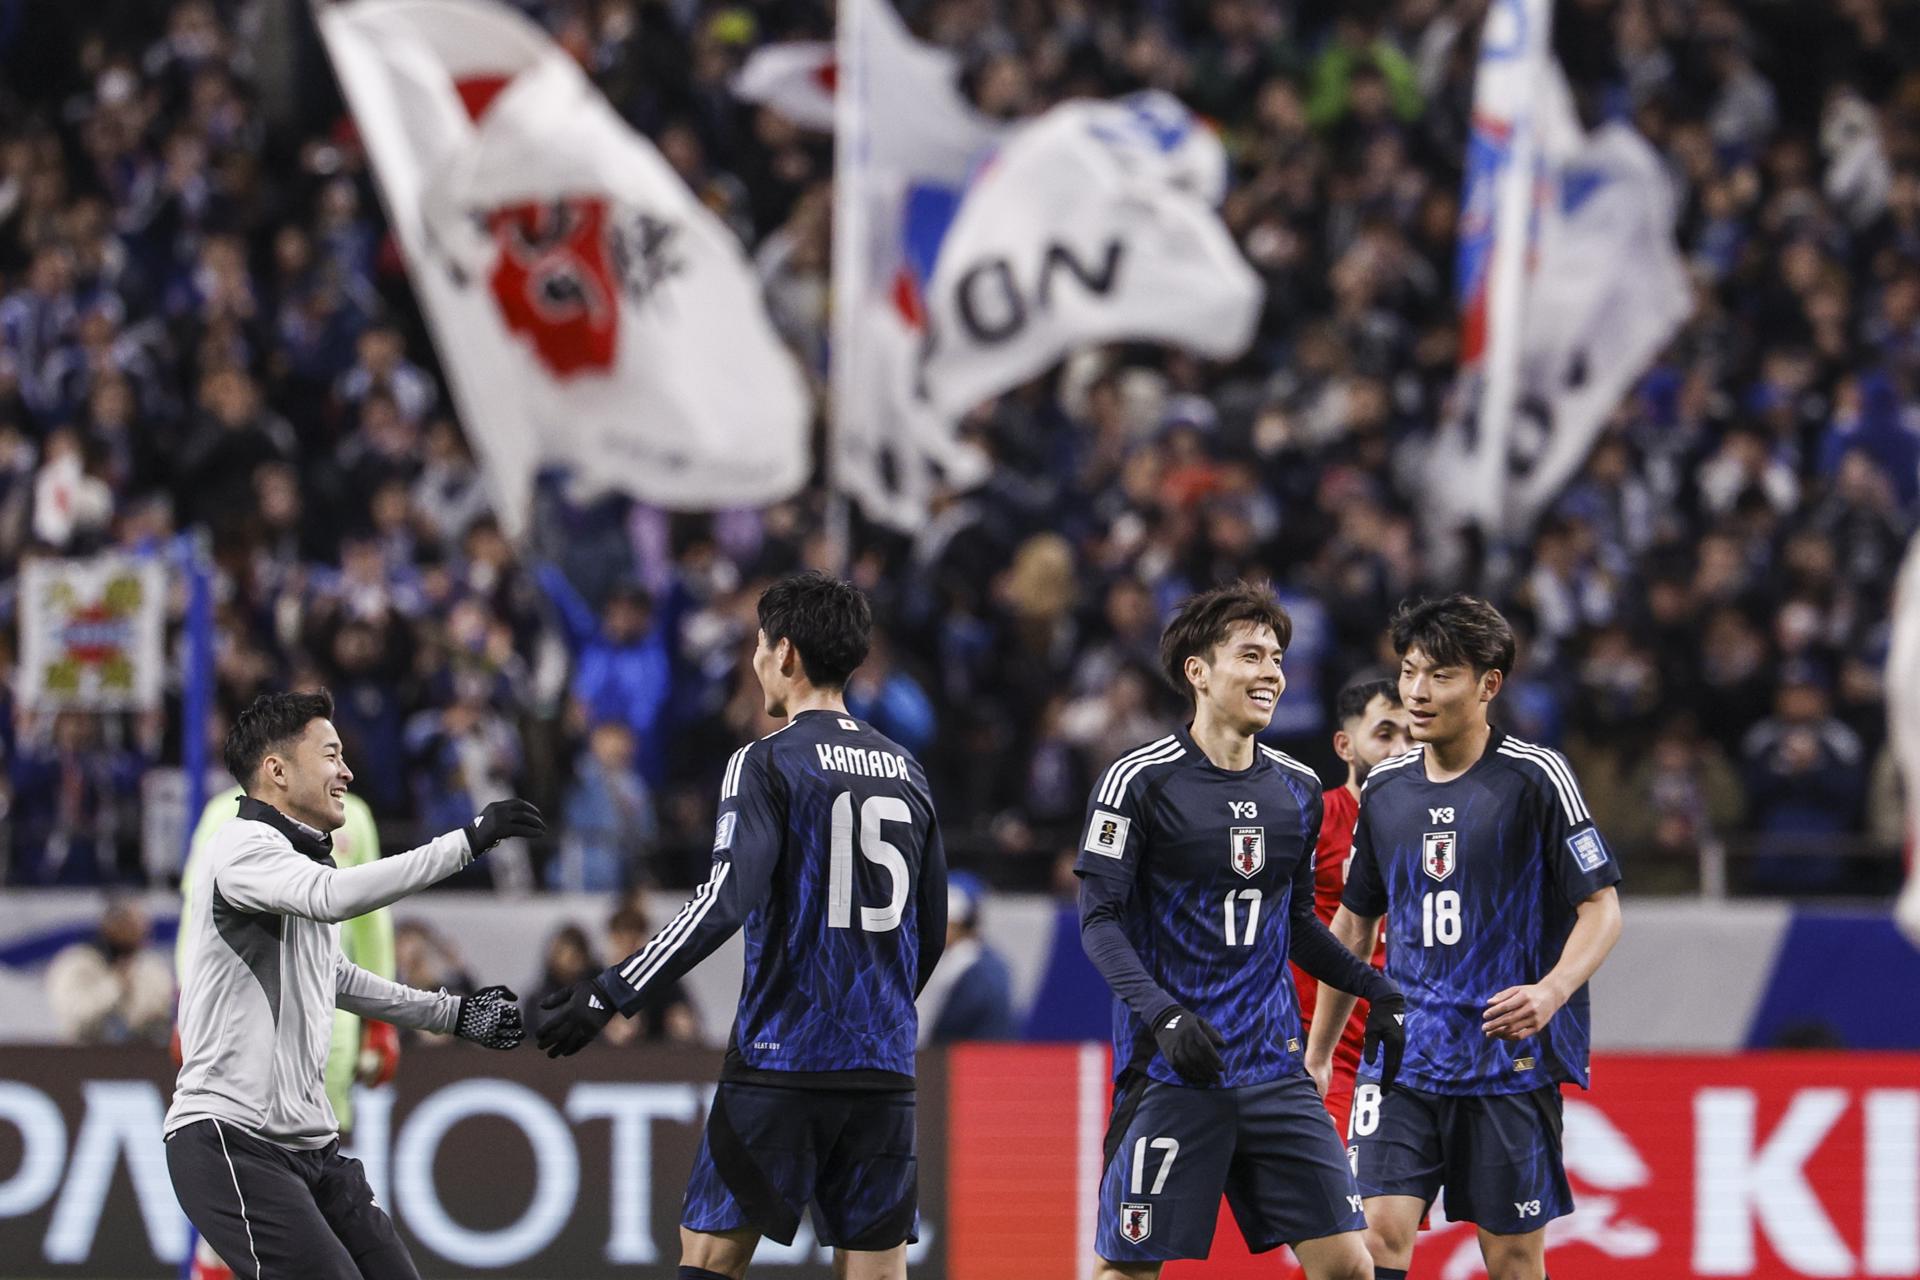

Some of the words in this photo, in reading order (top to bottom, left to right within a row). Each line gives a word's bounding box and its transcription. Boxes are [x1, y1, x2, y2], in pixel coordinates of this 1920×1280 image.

[815, 743, 911, 781] KAMADA
[1228, 801, 1258, 819] Y-3
[1428, 807, 1455, 825] Y-3
[828, 791, 912, 932] 15
[1224, 889, 1263, 945] 17
[1422, 889, 1463, 947] 18
[1130, 1136, 1179, 1194] 17
[1514, 1200, 1541, 1218] Y-3
